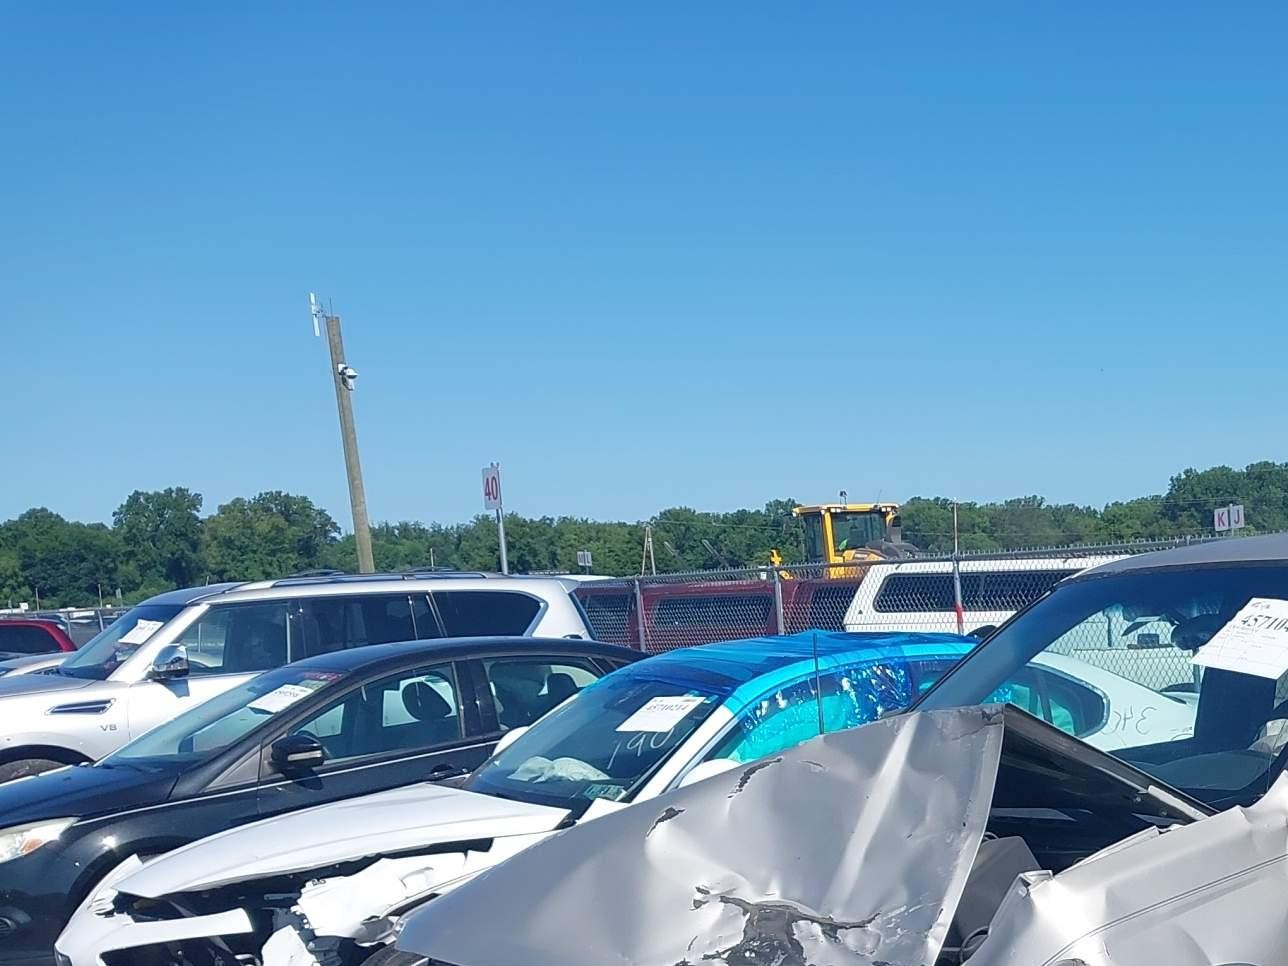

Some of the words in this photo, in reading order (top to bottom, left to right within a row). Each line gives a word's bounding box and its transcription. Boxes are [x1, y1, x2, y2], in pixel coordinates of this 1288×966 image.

[484, 476, 498, 501] 40
[1217, 511, 1225, 527] K
[1233, 509, 1240, 525] J
[100, 724, 118, 732] V8
